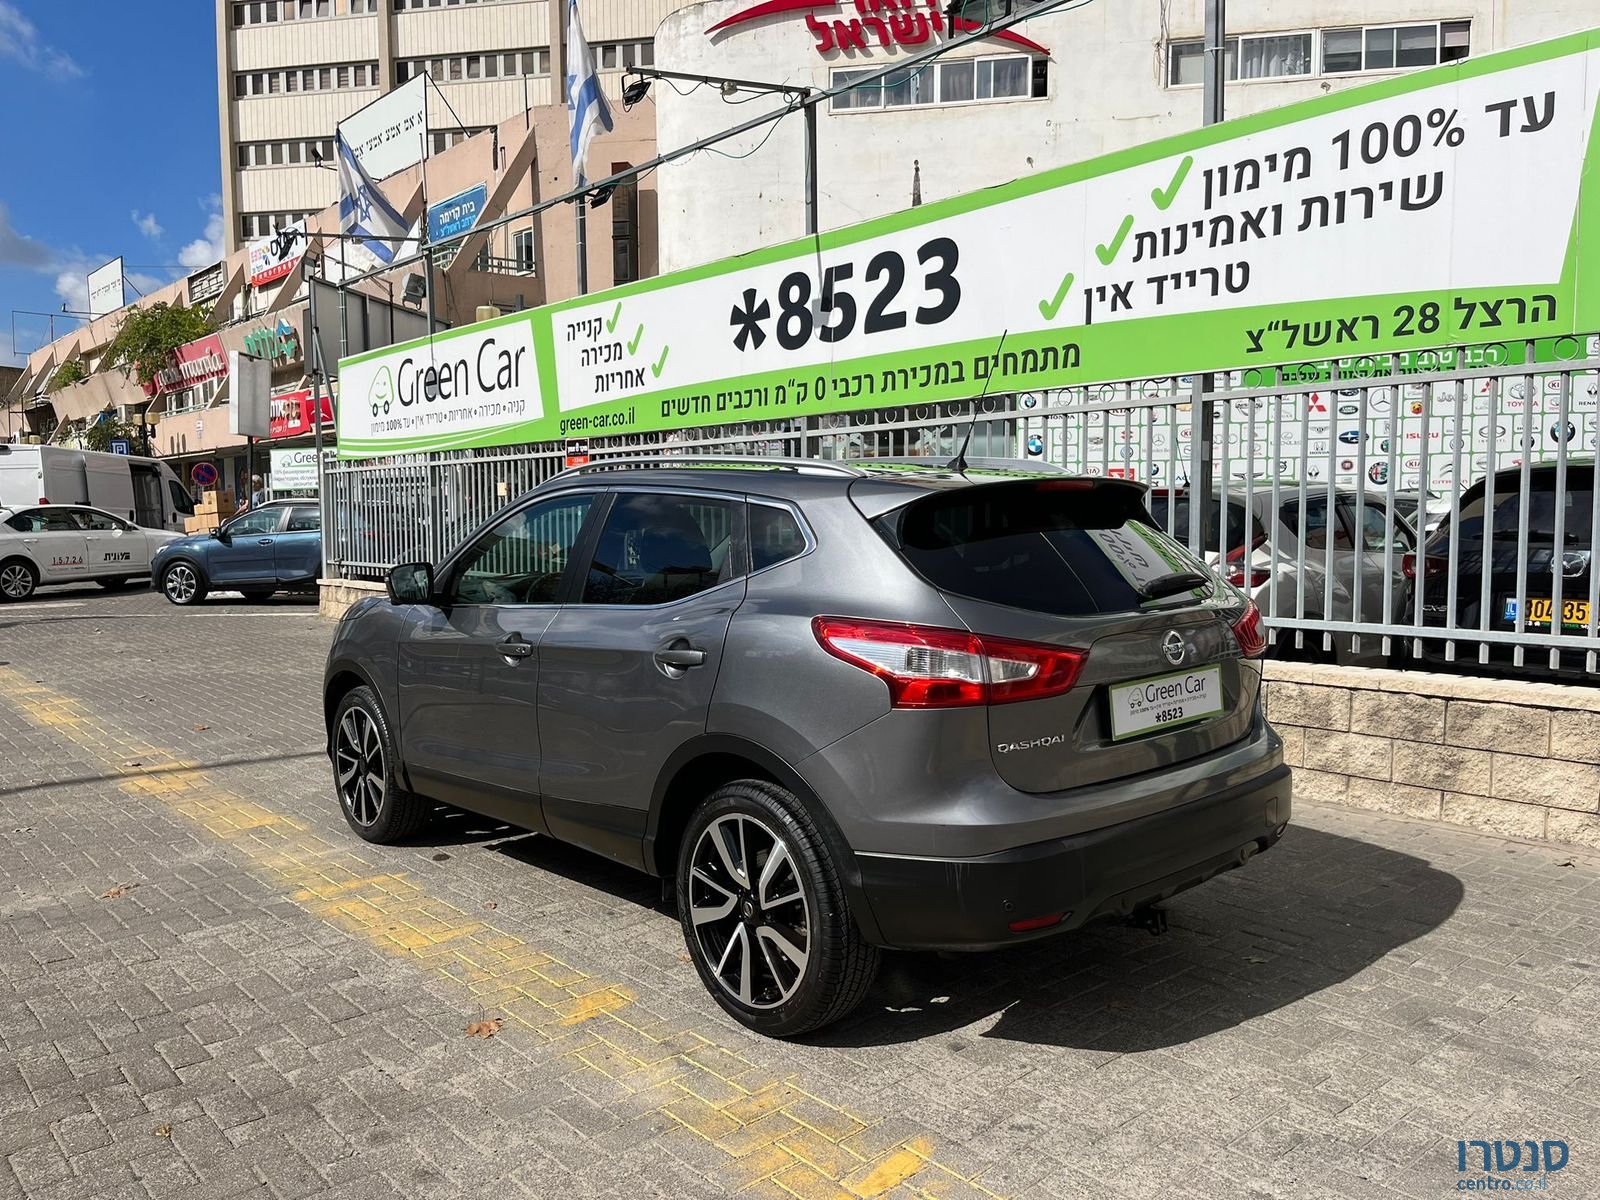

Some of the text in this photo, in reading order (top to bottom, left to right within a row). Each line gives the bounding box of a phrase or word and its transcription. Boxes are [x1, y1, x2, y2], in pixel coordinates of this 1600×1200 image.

[805, 11, 943, 52] ישראל
[1203, 91, 1555, 210] עד 100% מימון
[462, 201, 476, 216] בית
[1133, 171, 1443, 263] שירות ואמינות
[1084, 261, 1250, 325] טרייד אין
[1393, 302, 1440, 337] 28
[1454, 293, 1557, 331] הרצל
[567, 317, 602, 342] קנייה
[581, 342, 623, 367] מכירה
[974, 343, 1080, 380] מתמחים
[398, 338, 525, 407] Green Car
[594, 367, 646, 393] אחריות
[832, 373, 874, 398] רכבי
[881, 360, 965, 393] במכירת
[716, 387, 768, 411] ורכבים
[815, 376, 826, 400] 0
[478, 403, 501, 418] מכירה
[661, 395, 711, 418] חדשים
[386, 418, 402, 431] 100%
[560, 406, 635, 435] green-car.co.il
[1145, 675, 1206, 702] Green Car
[997, 734, 1065, 753] QASHQAI
